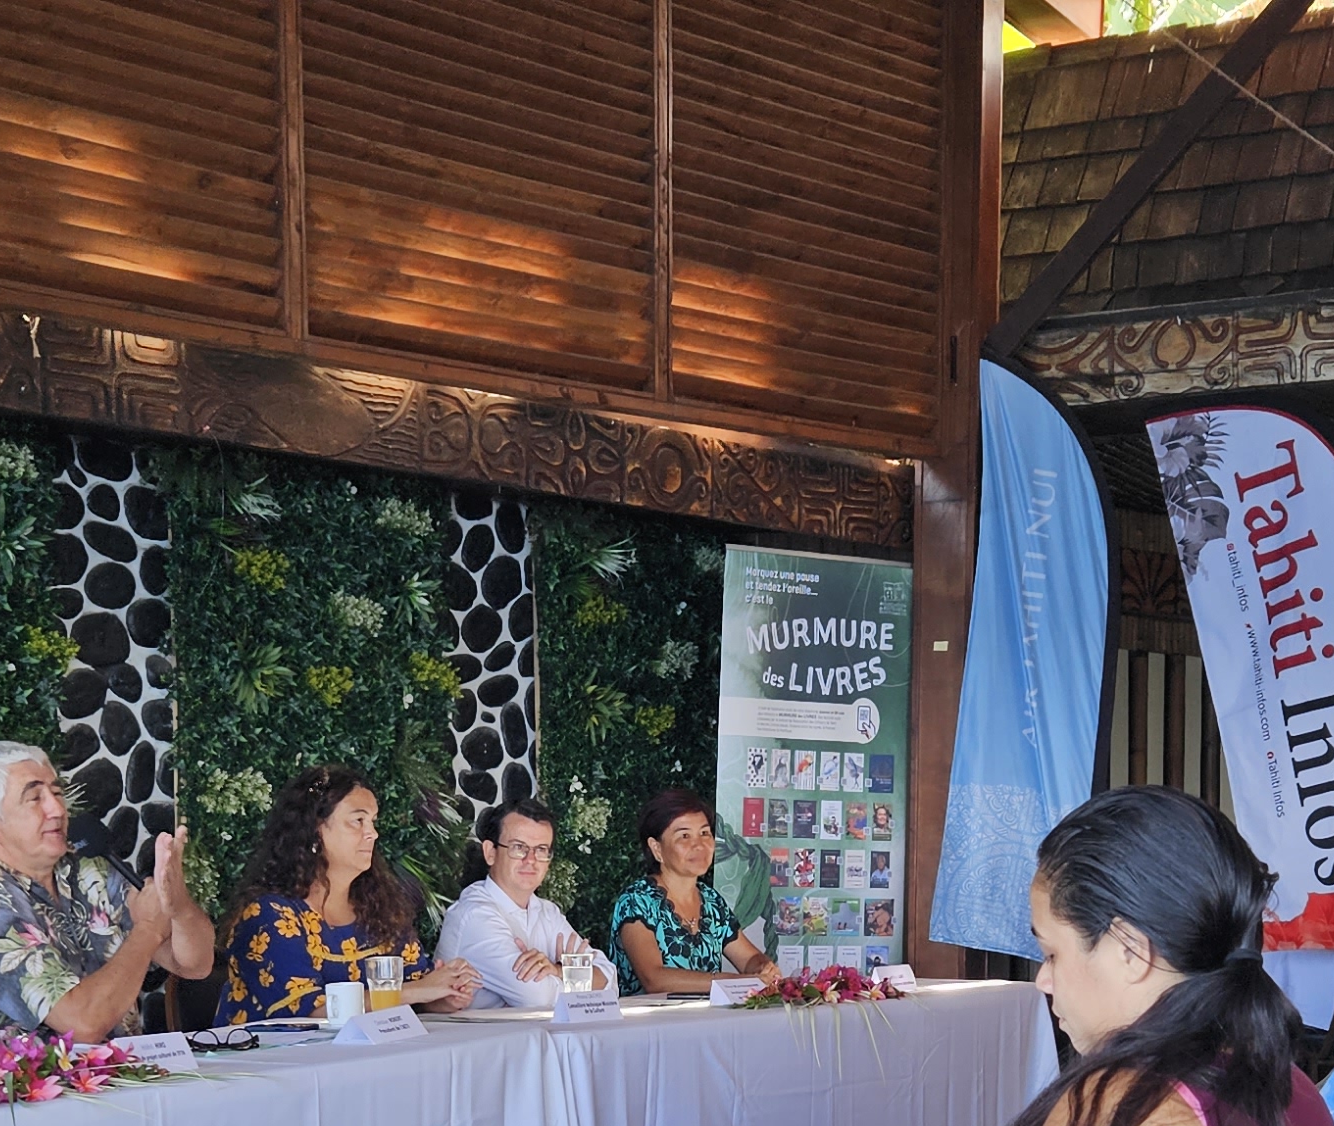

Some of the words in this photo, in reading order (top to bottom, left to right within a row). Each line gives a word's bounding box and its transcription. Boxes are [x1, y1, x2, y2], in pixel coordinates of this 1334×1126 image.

[1025, 468, 1058, 538] NUI
[796, 573, 819, 583] pause
[1234, 438, 1334, 680] Tahiti
[1227, 552, 1250, 612] tahiti_infos
[746, 617, 895, 655] MURMURE
[763, 666, 784, 688] des
[789, 656, 887, 696] LIVRES
[1247, 630, 1272, 741] www.tahiti-infos.com
[1267, 760, 1282, 789] Tahiti
[1272, 791, 1287, 818] Infos
